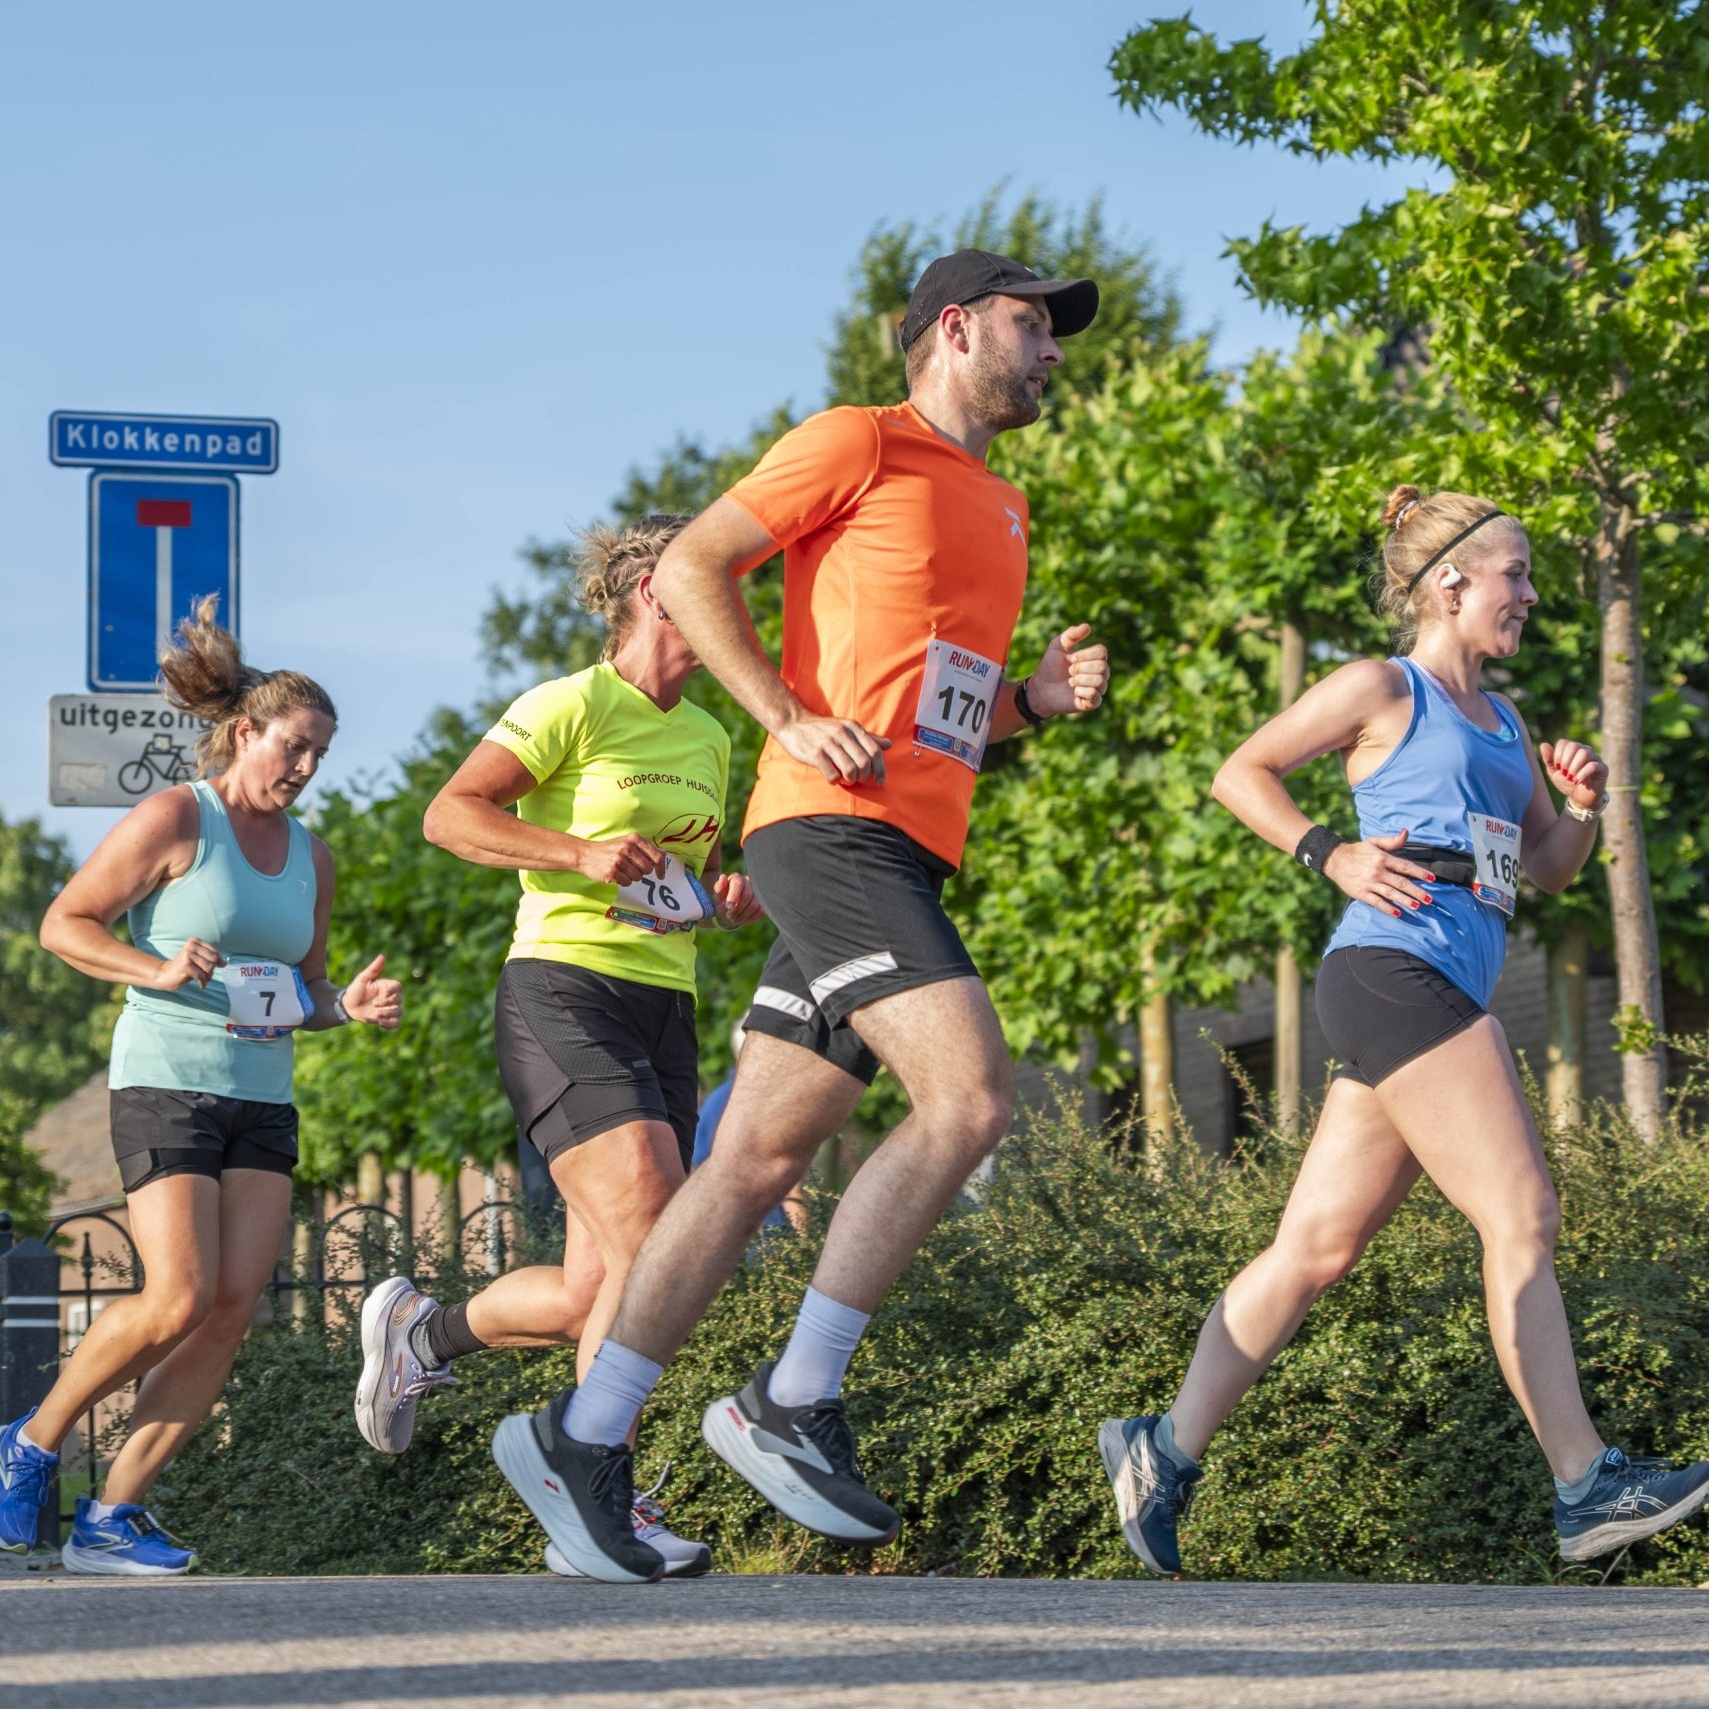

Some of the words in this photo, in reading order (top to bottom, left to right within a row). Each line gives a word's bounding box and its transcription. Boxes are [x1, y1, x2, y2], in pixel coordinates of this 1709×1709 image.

[66, 423, 262, 459] Klokkenpad
[938, 685, 986, 734] 170
[617, 773, 682, 790] LOOPGROEP
[1486, 849, 1519, 889] 169
[641, 877, 681, 911] 76
[259, 991, 276, 1017] 7
